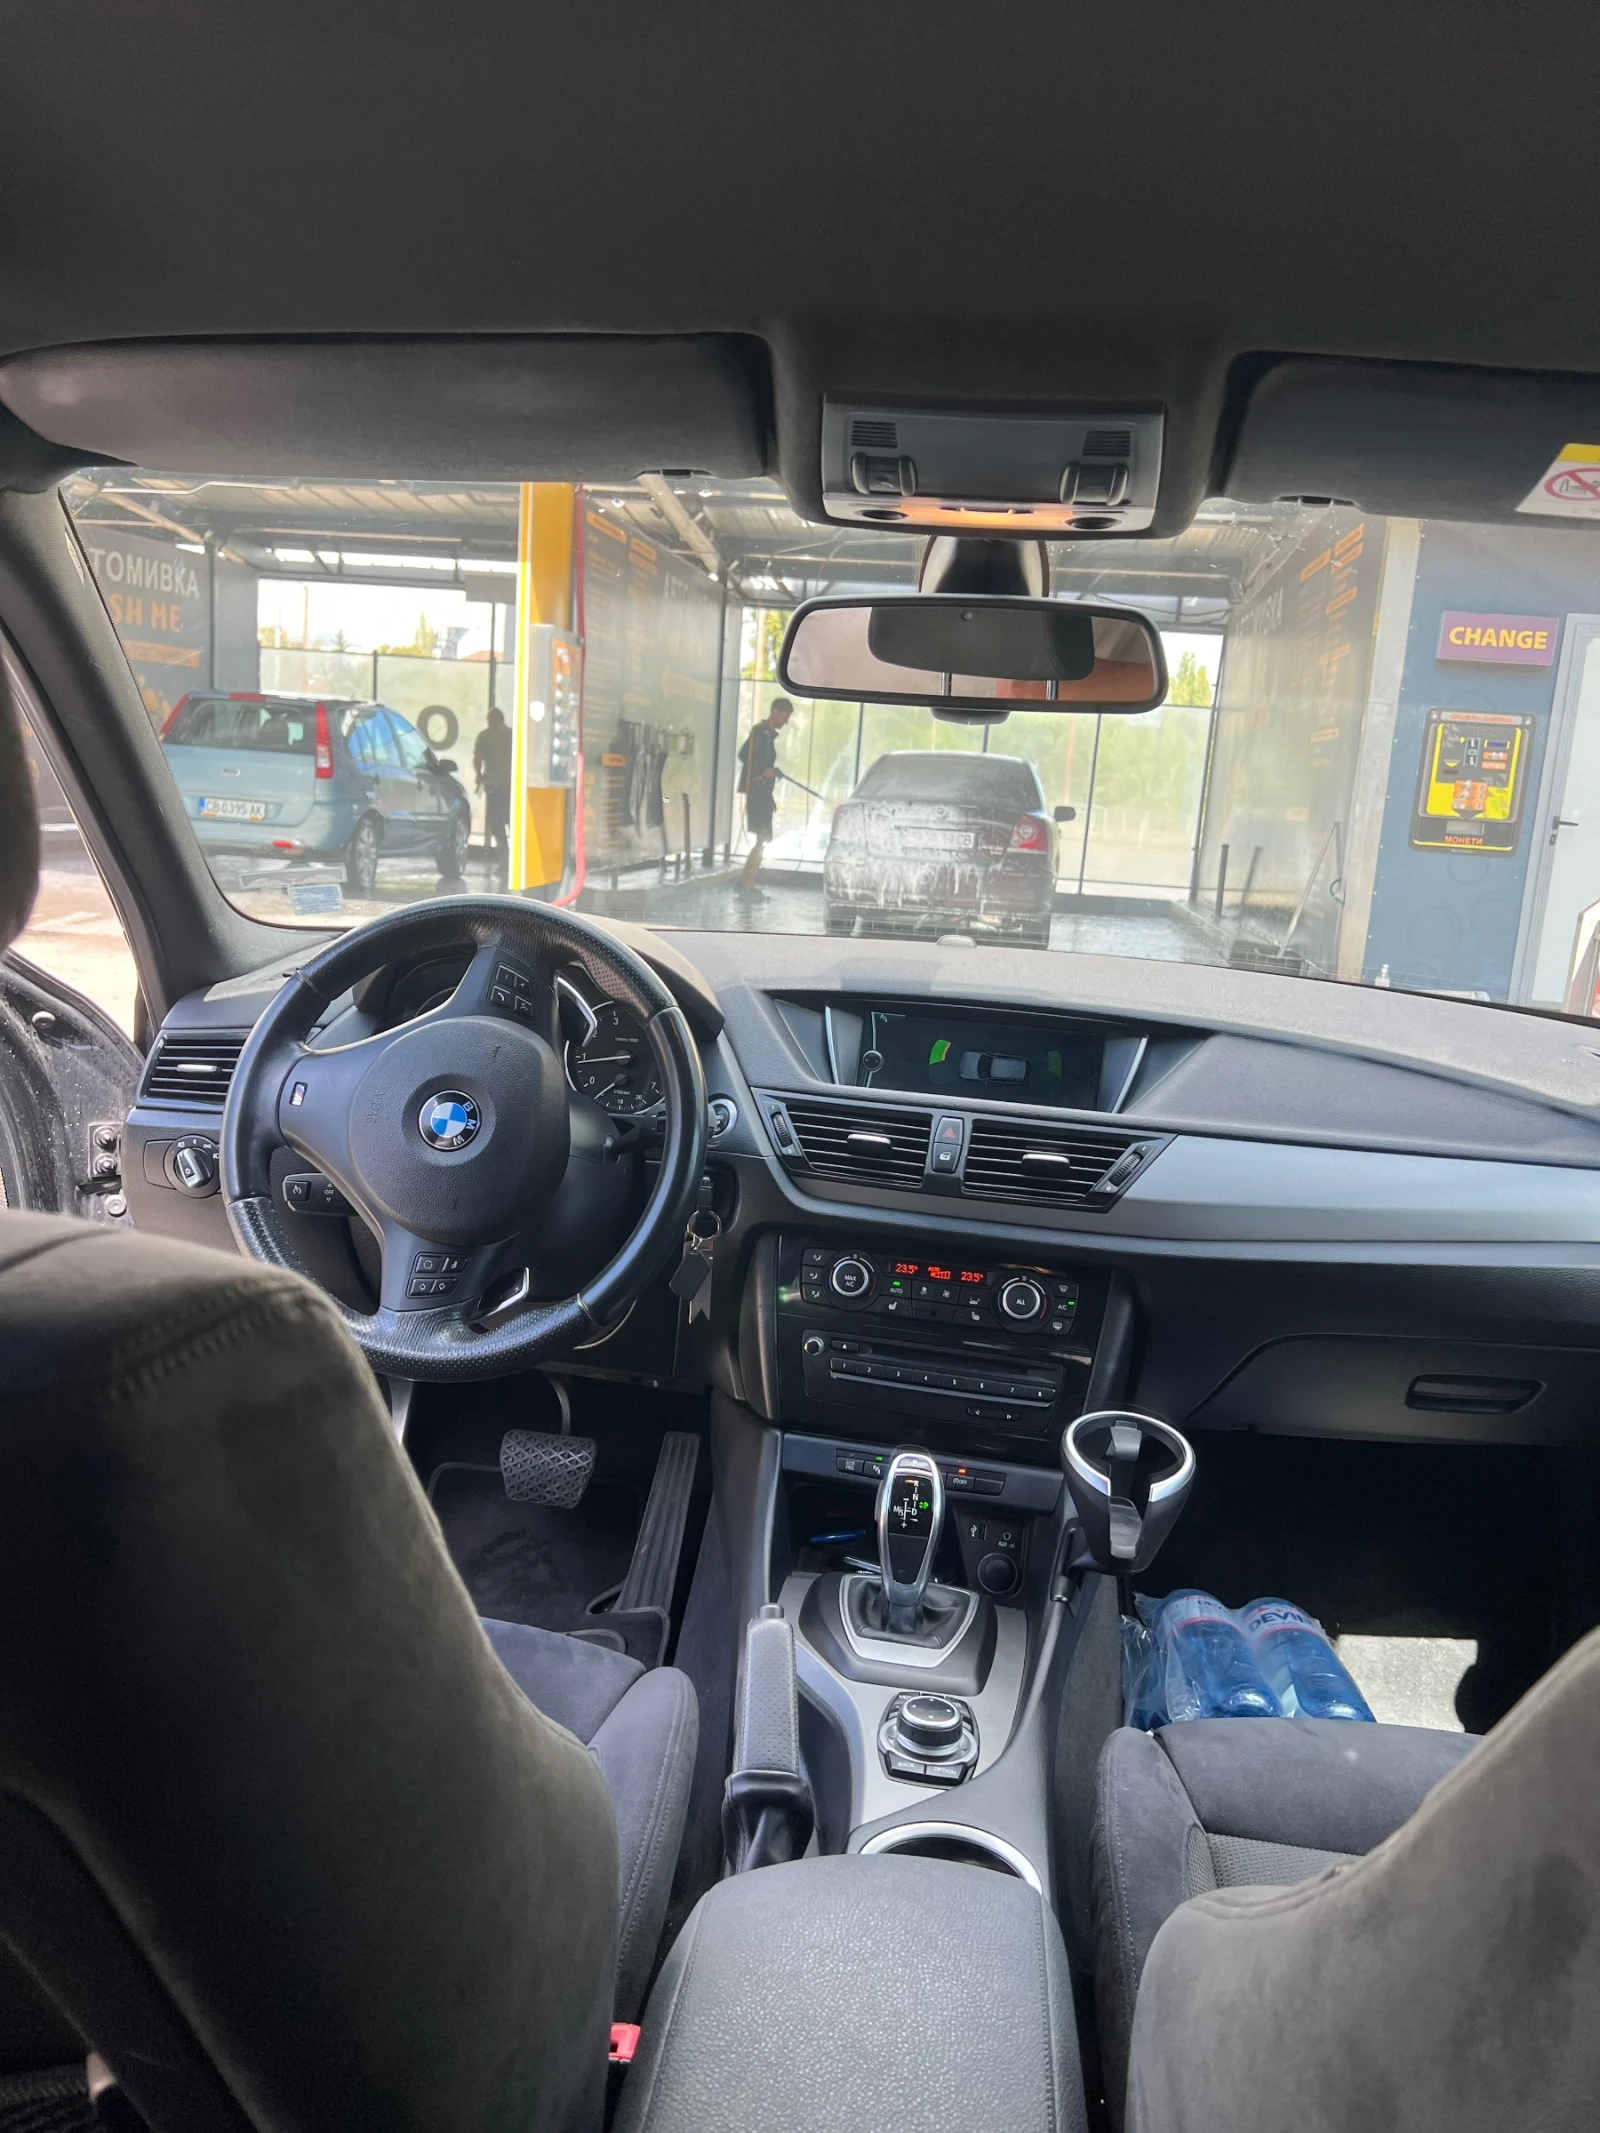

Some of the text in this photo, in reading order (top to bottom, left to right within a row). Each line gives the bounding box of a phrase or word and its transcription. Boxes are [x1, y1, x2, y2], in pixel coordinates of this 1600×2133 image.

[87, 547, 200, 599] ТОМИВКА
[109, 593, 182, 633] SH ME
[1448, 626, 1548, 650] CHANGE
[1444, 836, 1483, 846] МОНЕТИ
[612, 1017, 620, 1026] 3
[589, 1076, 595, 1085] 0
[452, 1100, 477, 1146] BMW
[844, 1274, 857, 1282] MAX
[845, 1280, 855, 1288] A/C
[1016, 1298, 1026, 1306] ALL
[911, 1507, 918, 1516] D
[933, 1766, 957, 1775] OPTION
